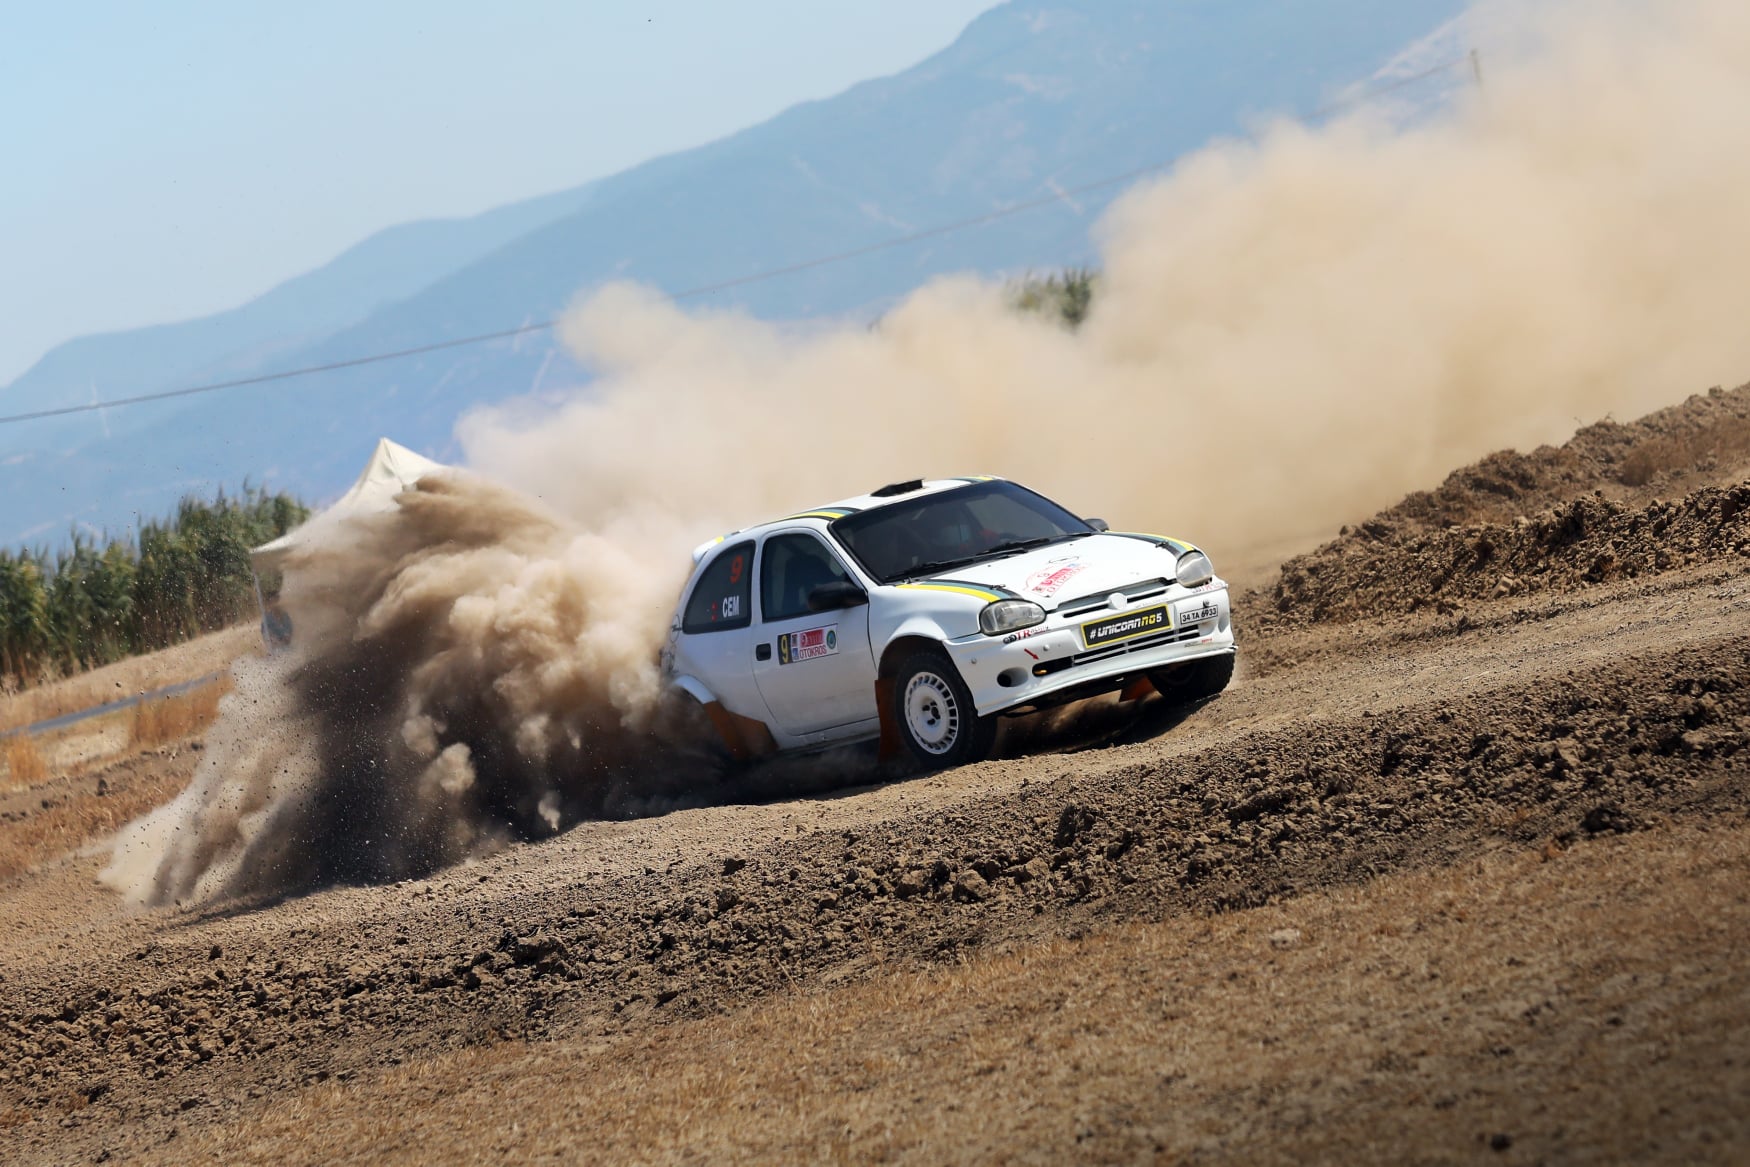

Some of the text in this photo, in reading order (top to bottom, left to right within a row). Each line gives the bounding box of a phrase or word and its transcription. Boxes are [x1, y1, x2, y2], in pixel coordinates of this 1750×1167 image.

[730, 555, 743, 584] 9
[723, 595, 740, 618] CEM
[1182, 614, 1191, 622] 34
[1191, 612, 1200, 620] TA
[781, 635, 789, 664] 9
[800, 644, 827, 659] OTOKROS
